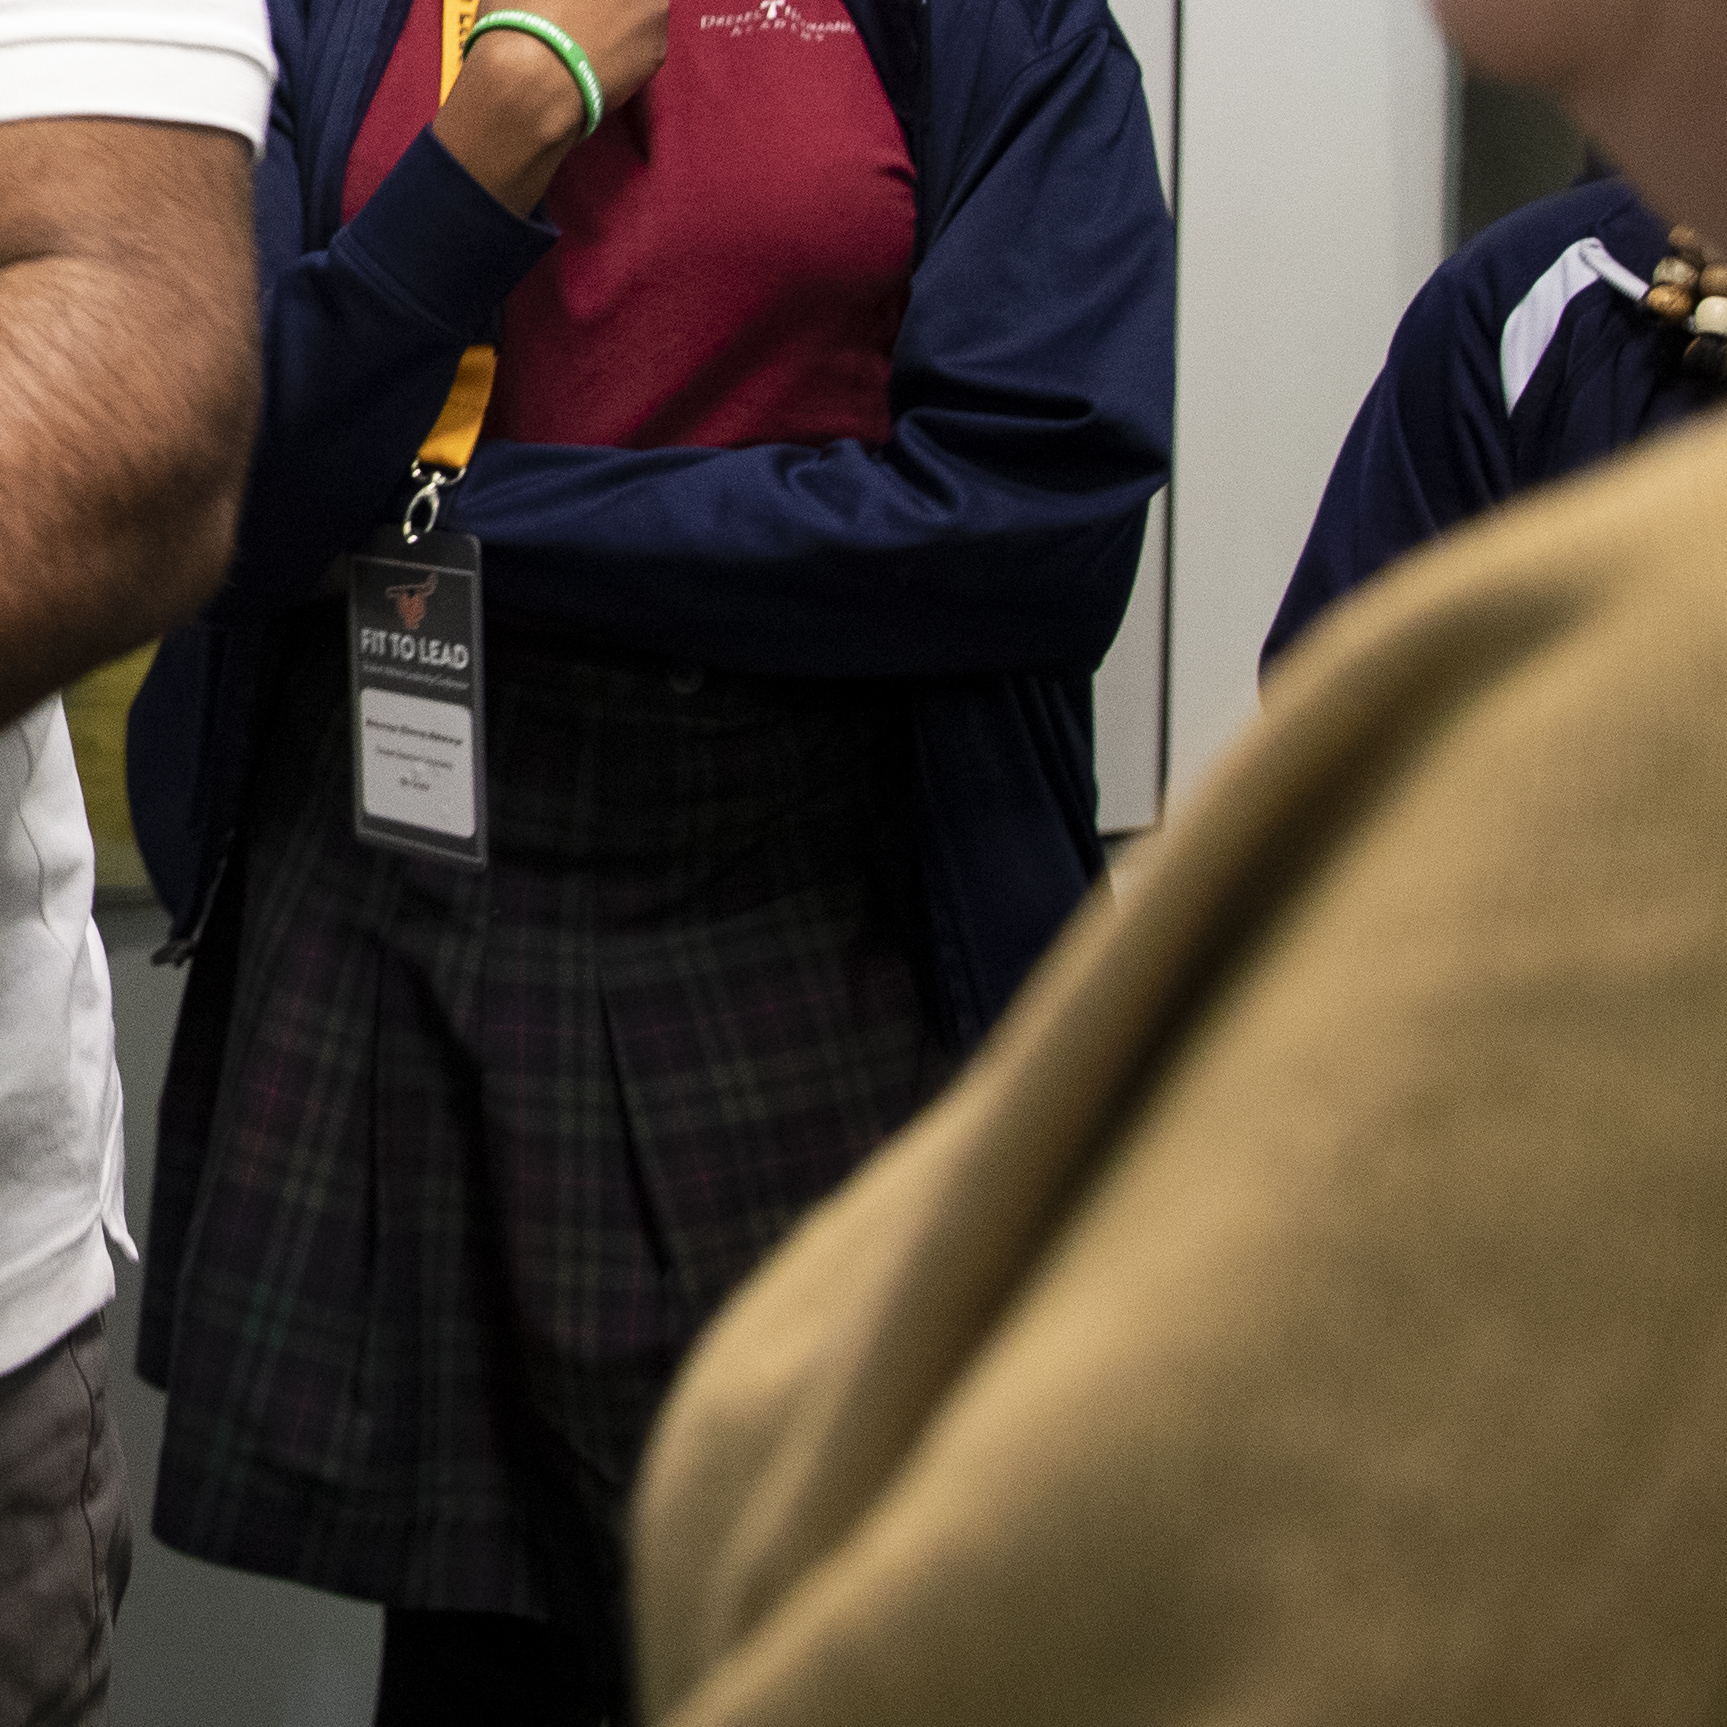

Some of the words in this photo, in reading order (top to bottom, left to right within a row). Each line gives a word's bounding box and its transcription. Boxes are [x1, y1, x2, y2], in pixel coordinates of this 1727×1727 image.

[360, 627, 387, 655] FIT
[388, 633, 416, 661] TO
[418, 637, 470, 670] LEAD
